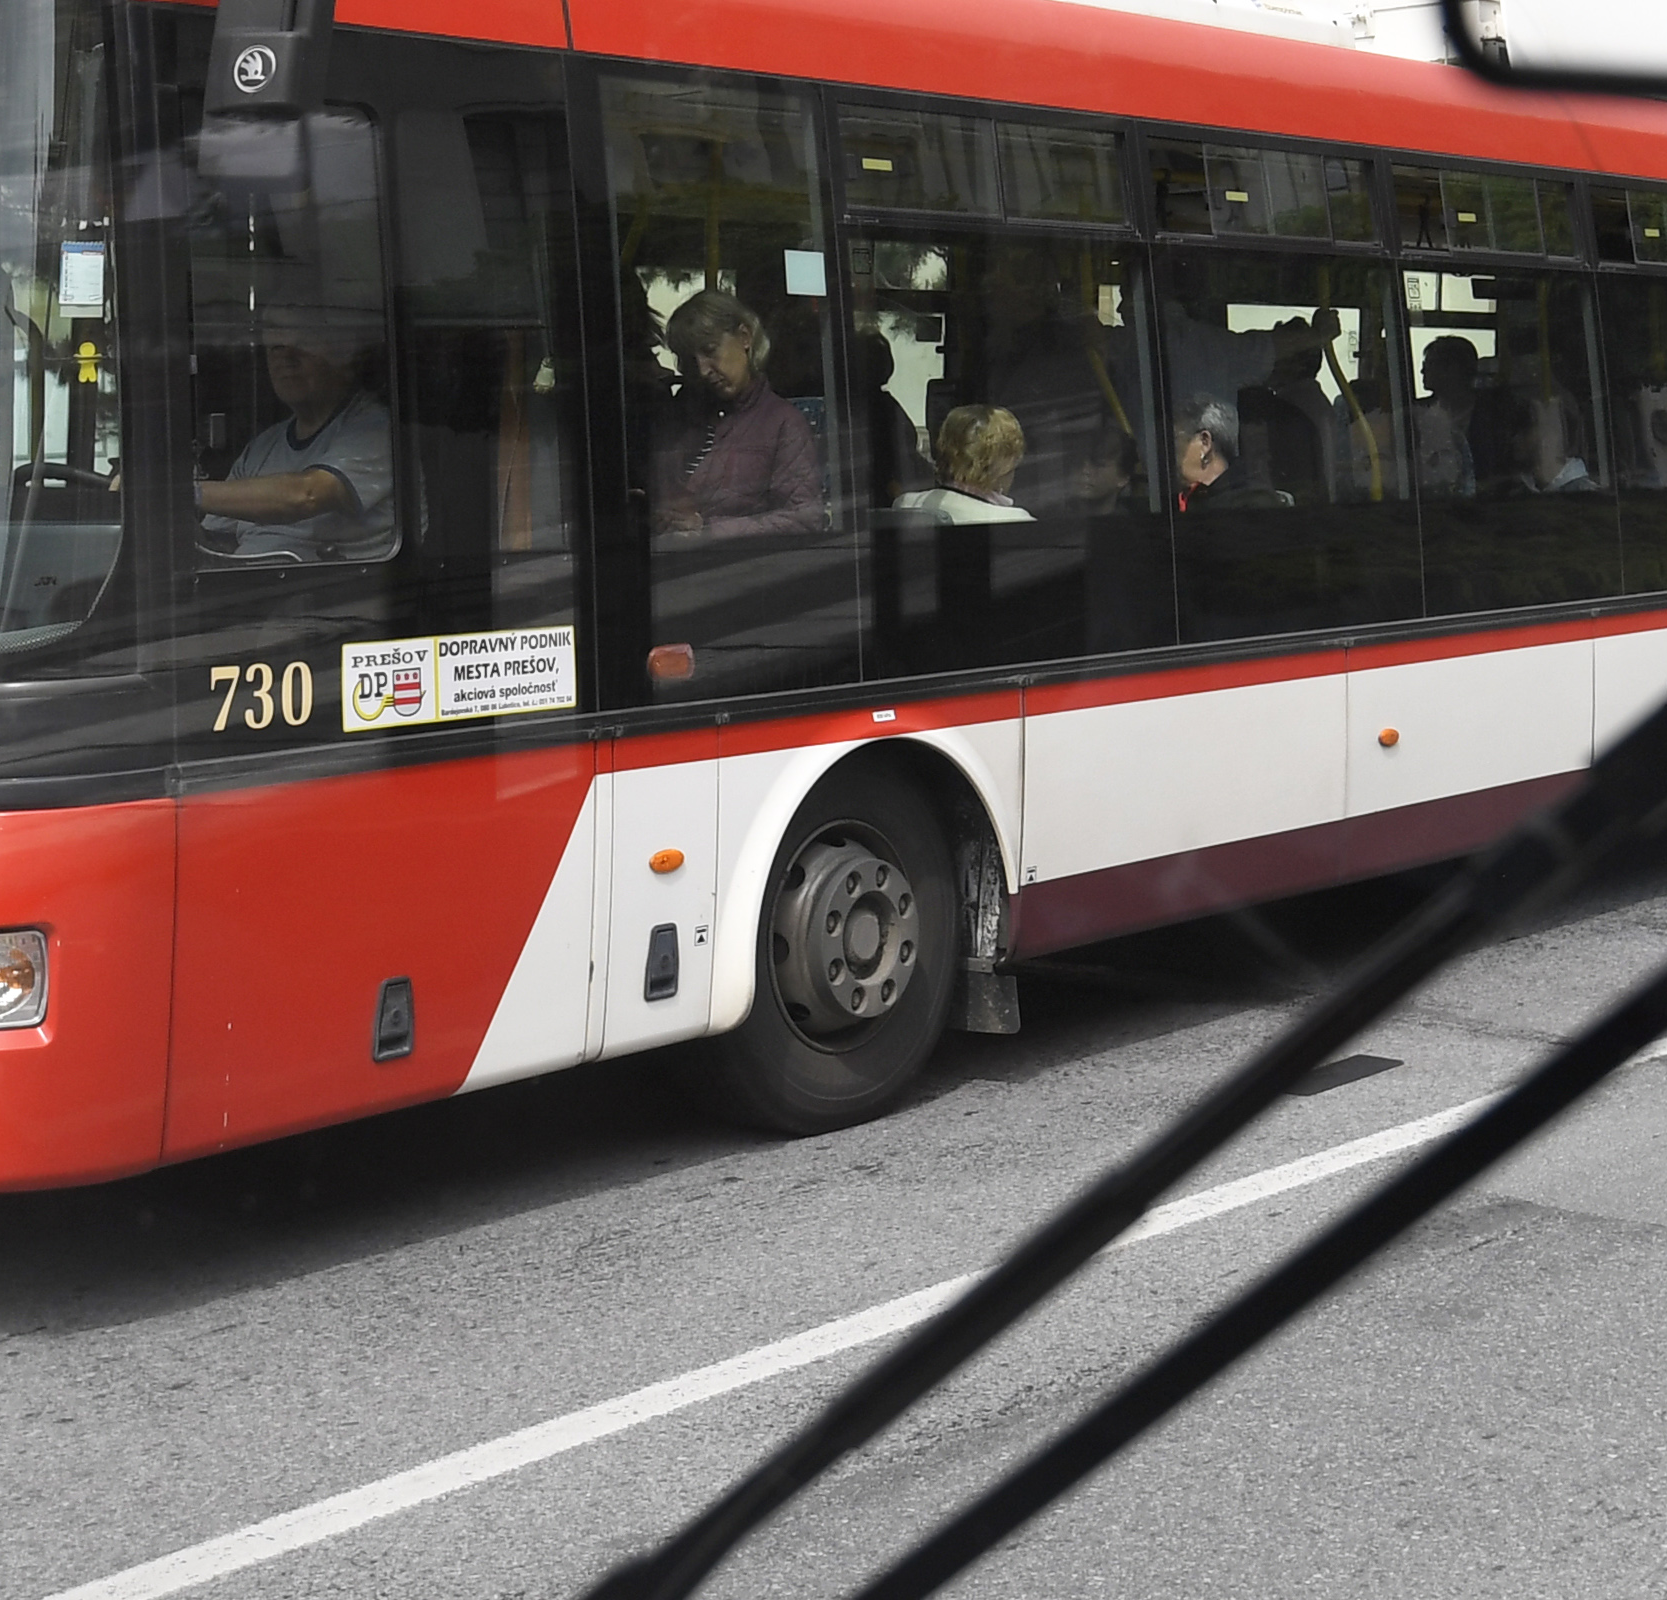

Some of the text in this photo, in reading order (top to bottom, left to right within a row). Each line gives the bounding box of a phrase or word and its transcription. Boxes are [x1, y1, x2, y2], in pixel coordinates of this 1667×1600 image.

[439, 631, 571, 657] DOPRAVNÝ PODNIK
[351, 647, 429, 668] PREŠOV
[453, 655, 559, 681] MESTA PREŠOV,
[209, 660, 314, 732] 730
[358, 671, 388, 699] DP
[453, 679, 558, 703] akciová spoločnosť
